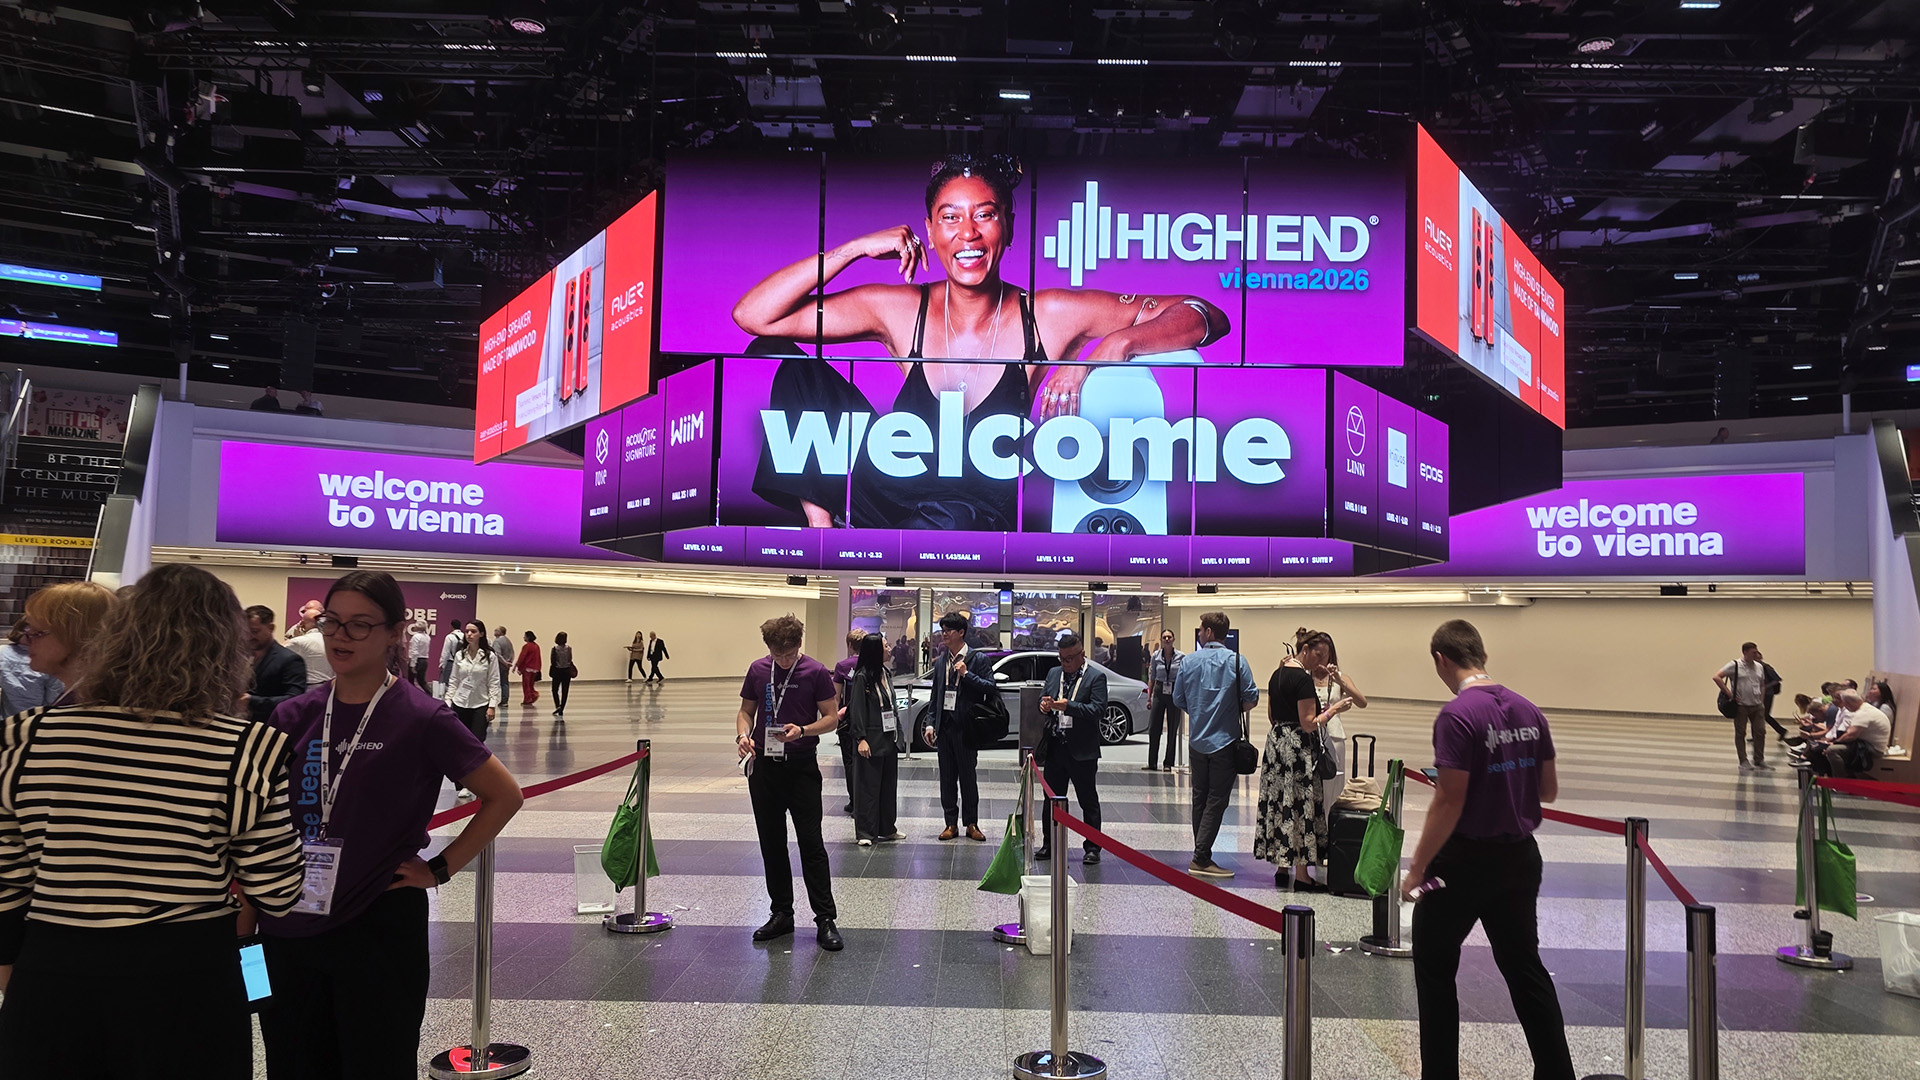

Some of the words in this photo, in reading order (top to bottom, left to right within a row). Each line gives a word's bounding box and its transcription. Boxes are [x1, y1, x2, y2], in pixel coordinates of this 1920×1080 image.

[1117, 213, 1258, 262] HIGH
[1425, 216, 1452, 256] AUER
[1425, 241, 1452, 271] acoustics
[1219, 267, 1369, 290] vienna2026
[1514, 280, 1527, 304] MADE
[612, 281, 644, 316] AUER
[1536, 282, 1555, 312] SPEAKER
[508, 310, 532, 338] SPEAKER
[610, 306, 643, 331] acoustics
[482, 355, 496, 375] MADE
[497, 349, 504, 367] OF
[671, 410, 704, 446] WiiM
[760, 391, 1292, 484] welcome
[48, 453, 67, 464] BE
[80, 457, 110, 466] THE
[625, 444, 656, 462] SIGNATURE
[21, 470, 93, 482] CENTRE
[1347, 458, 1365, 477] LINN
[1420, 462, 1443, 484] epos
[15, 486, 48, 498] THE
[61, 490, 106, 501] MUS
[318, 470, 483, 505] welcome
[328, 499, 375, 528] to
[386, 502, 504, 536] vienna
[1526, 499, 1698, 528] welcome
[1536, 530, 1582, 558] to
[1592, 528, 1723, 557] vienna
[1520, 726, 1540, 741] END
[297, 739, 324, 805] team
